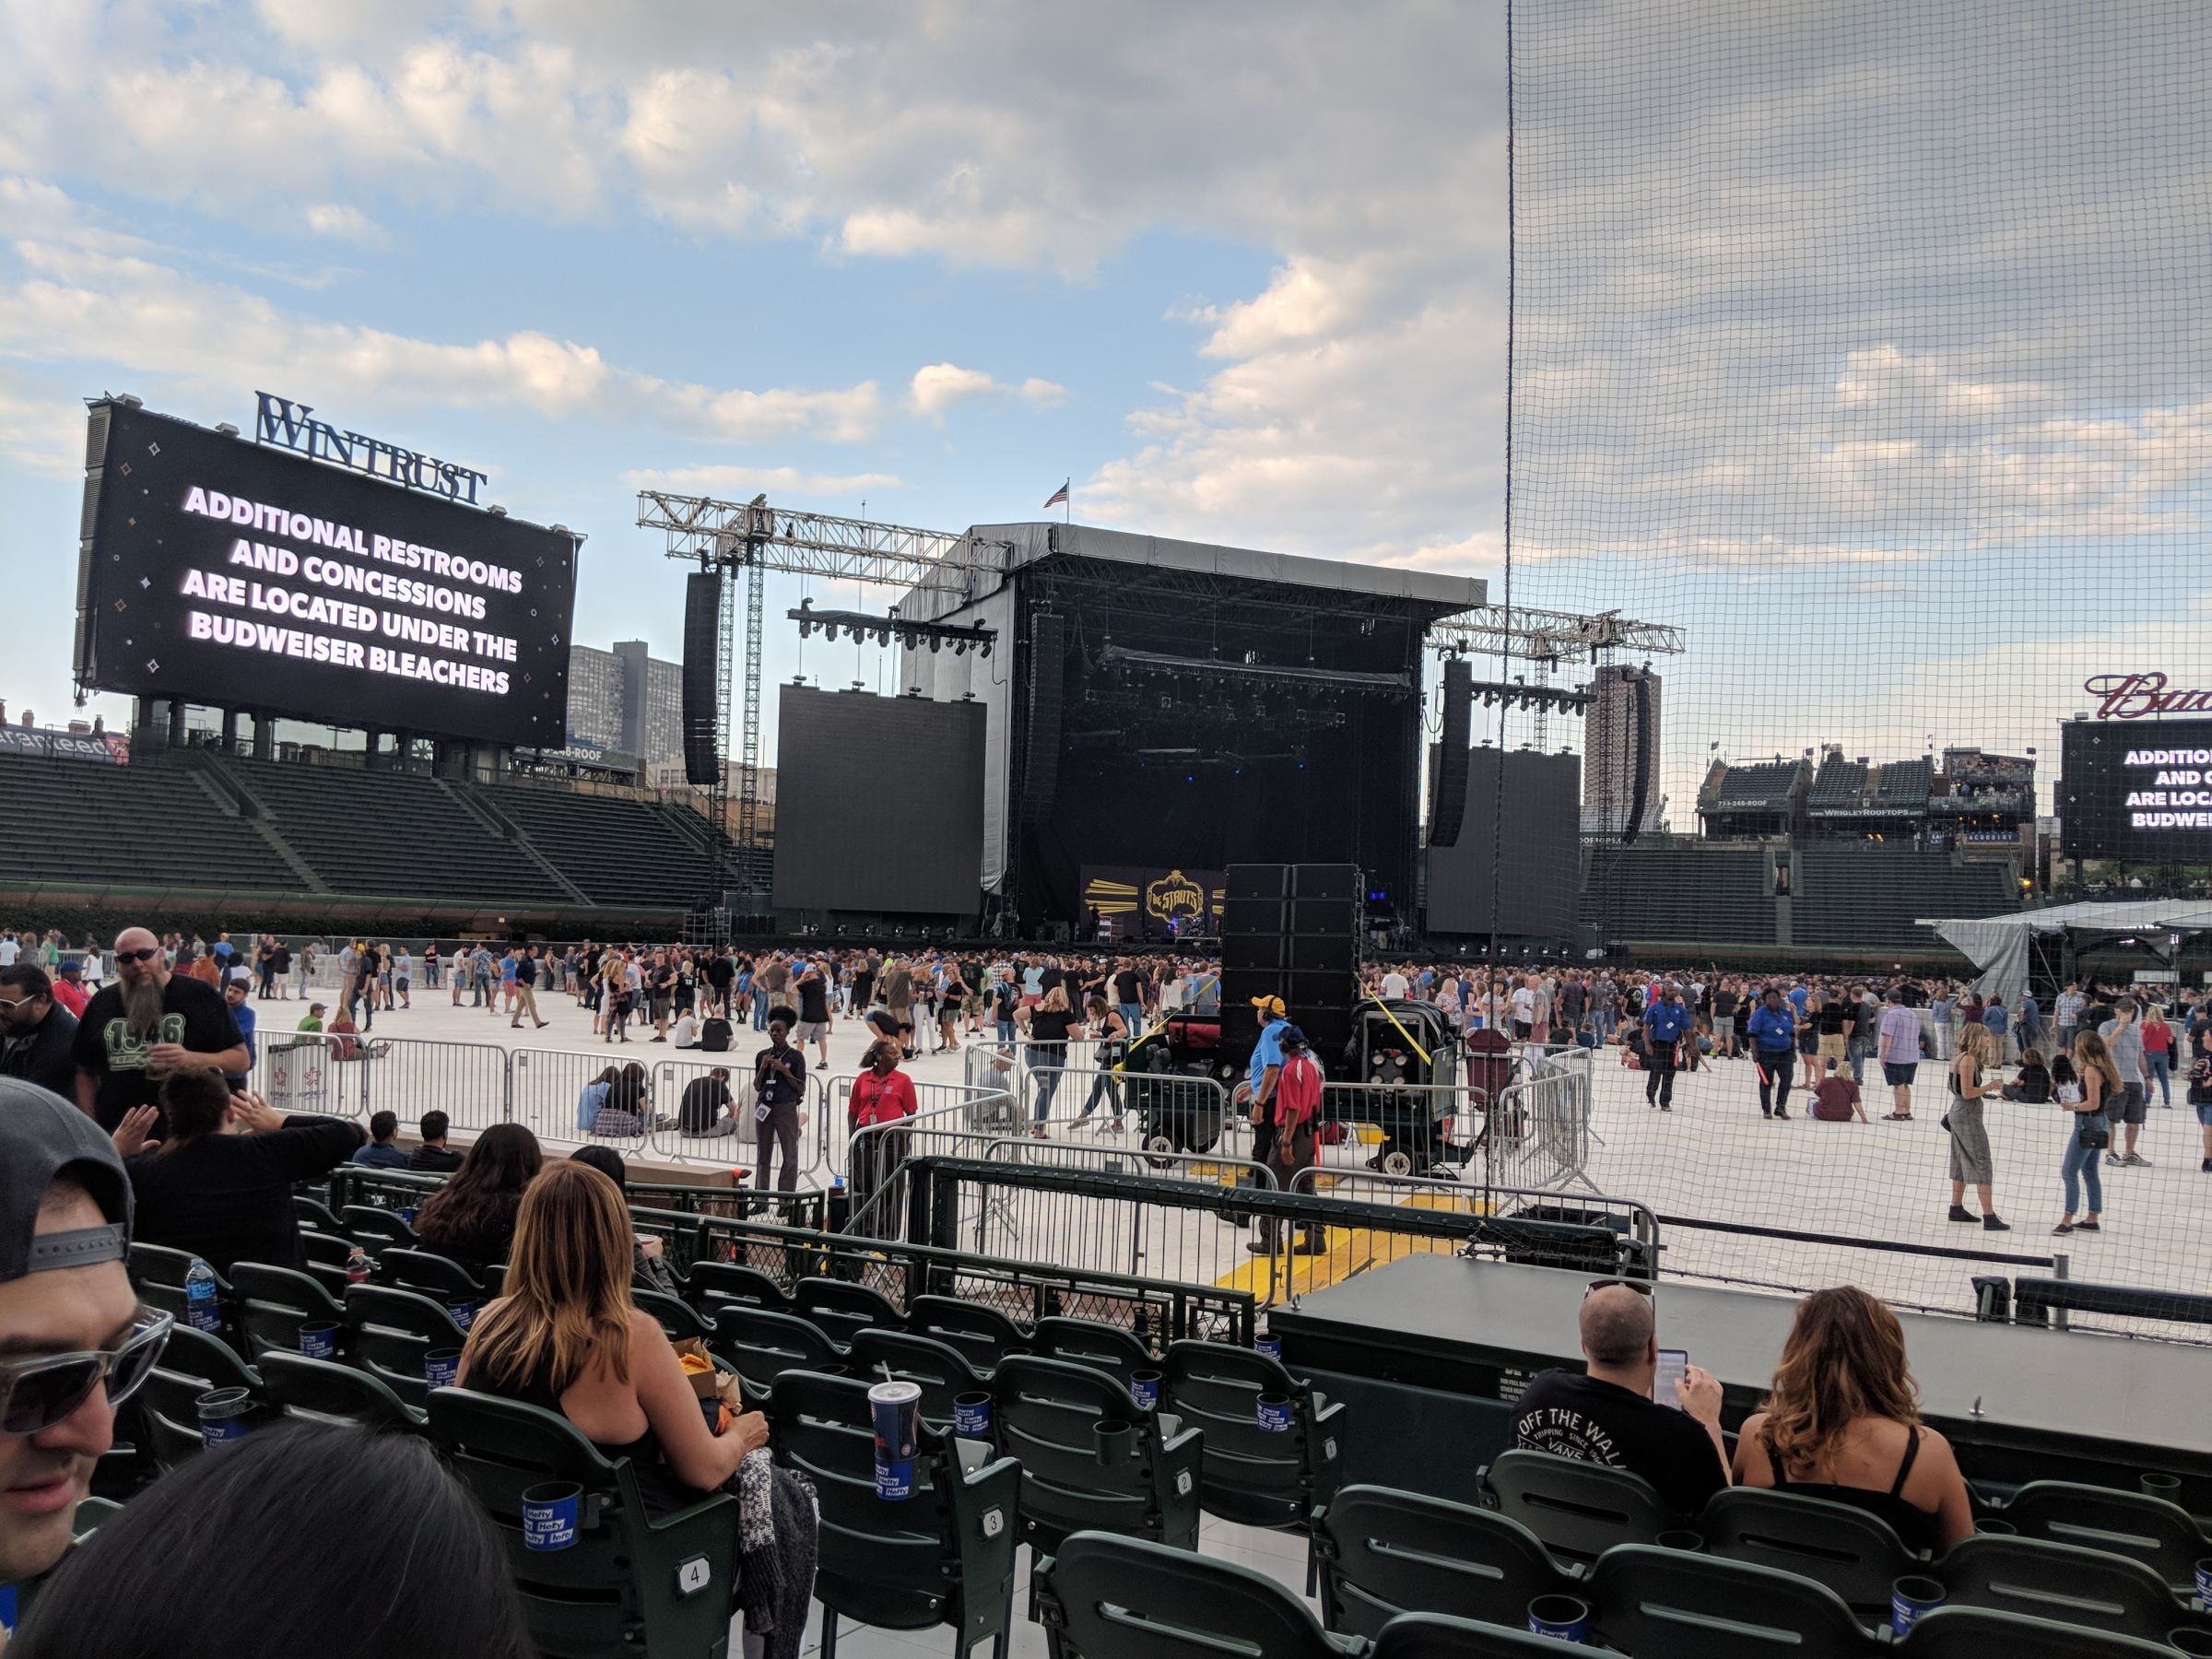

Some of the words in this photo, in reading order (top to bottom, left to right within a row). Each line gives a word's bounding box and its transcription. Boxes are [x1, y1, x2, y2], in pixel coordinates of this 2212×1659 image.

[255, 391, 487, 505] WINTRUST
[183, 486, 369, 556] ADDITIONAL
[373, 534, 523, 594] RESTROOMS
[230, 538, 299, 576] AND
[303, 556, 487, 619] CONCESSIONS
[182, 569, 246, 606] ARE
[251, 582, 378, 631] LOCATED
[382, 611, 469, 652] UNDER
[473, 631, 518, 662] THE
[191, 610, 364, 668] BUDWEISER
[369, 646, 510, 695] BLEACHERS
[2124, 750, 2212, 765] ADDITIO
[2155, 771, 2201, 785] AND
[2125, 792, 2167, 806] ARE
[1162, 889, 1197, 913] STRUTS
[1519, 1410, 1543, 1435] OFF
[1549, 1408, 1583, 1430] THE
[1534, 1429, 1564, 1441] TRIPPING
[1569, 1433, 1589, 1449] SINCE
[886, 1487, 909, 1496] Hefty
[1182, 1476, 1188, 1490] 2
[528, 1510, 553, 1520] Hefty
[990, 1514, 997, 1531] 3
[538, 1520, 565, 1531] Hefty
[690, 1565, 700, 1584] 4
